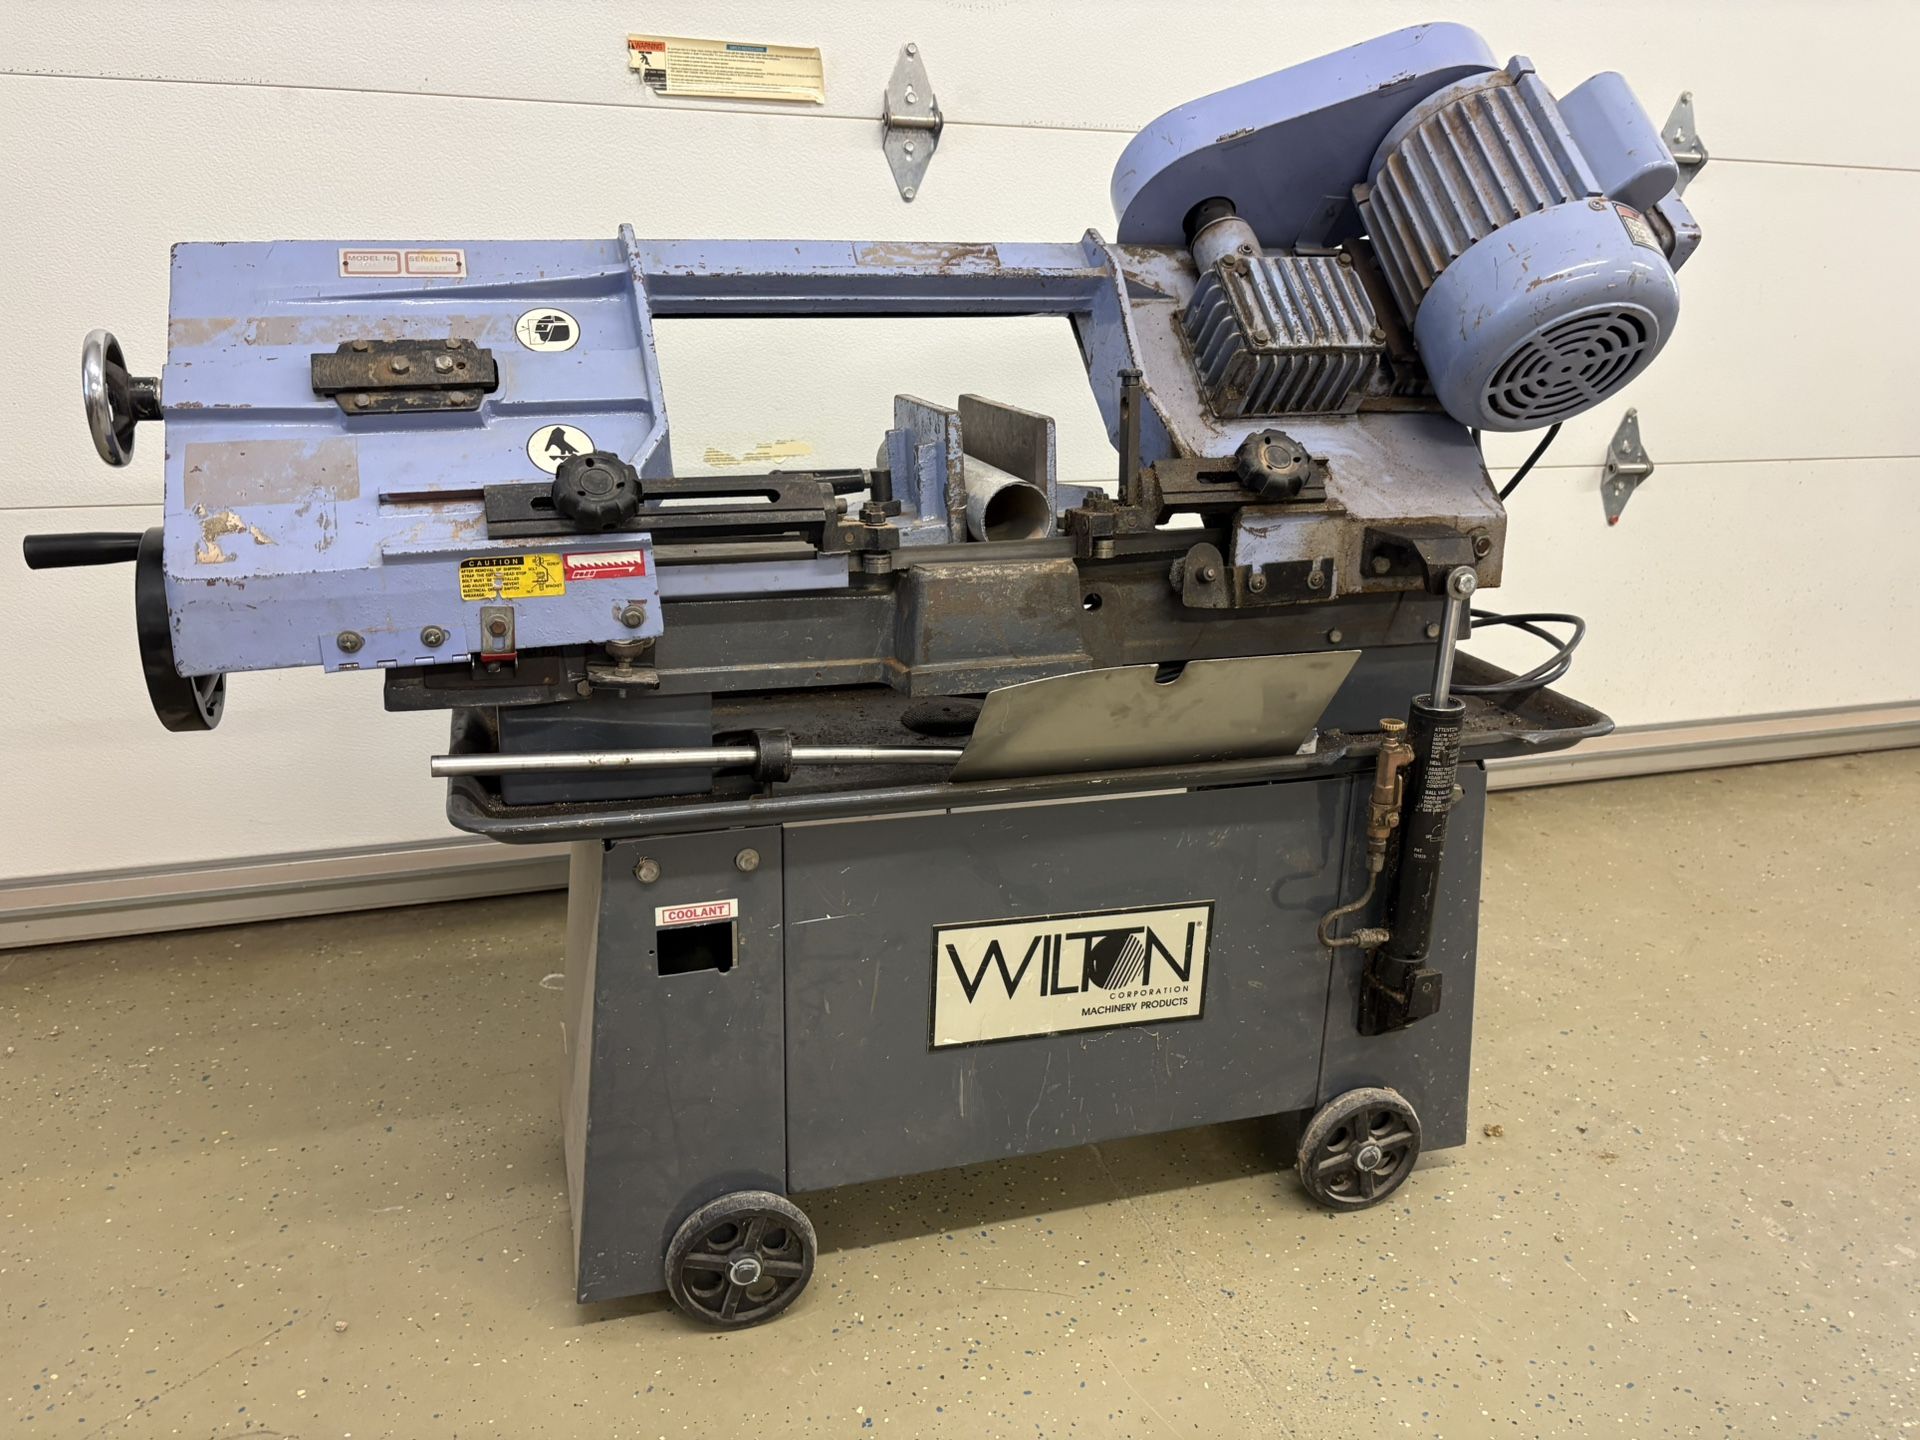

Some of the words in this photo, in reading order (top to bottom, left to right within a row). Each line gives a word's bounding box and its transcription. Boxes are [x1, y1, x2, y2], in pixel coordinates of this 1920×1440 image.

[635, 42, 662, 51] WARNING
[409, 254, 440, 262] SERIAL
[468, 558, 518, 567] CAUTION
[668, 905, 724, 920] COOLANT
[945, 921, 1195, 1004] WILTON
[1109, 984, 1190, 1000] CORPORATION
[1081, 1003, 1137, 1017] MACHINERY
[1140, 996, 1188, 1010] PRODUCTS
